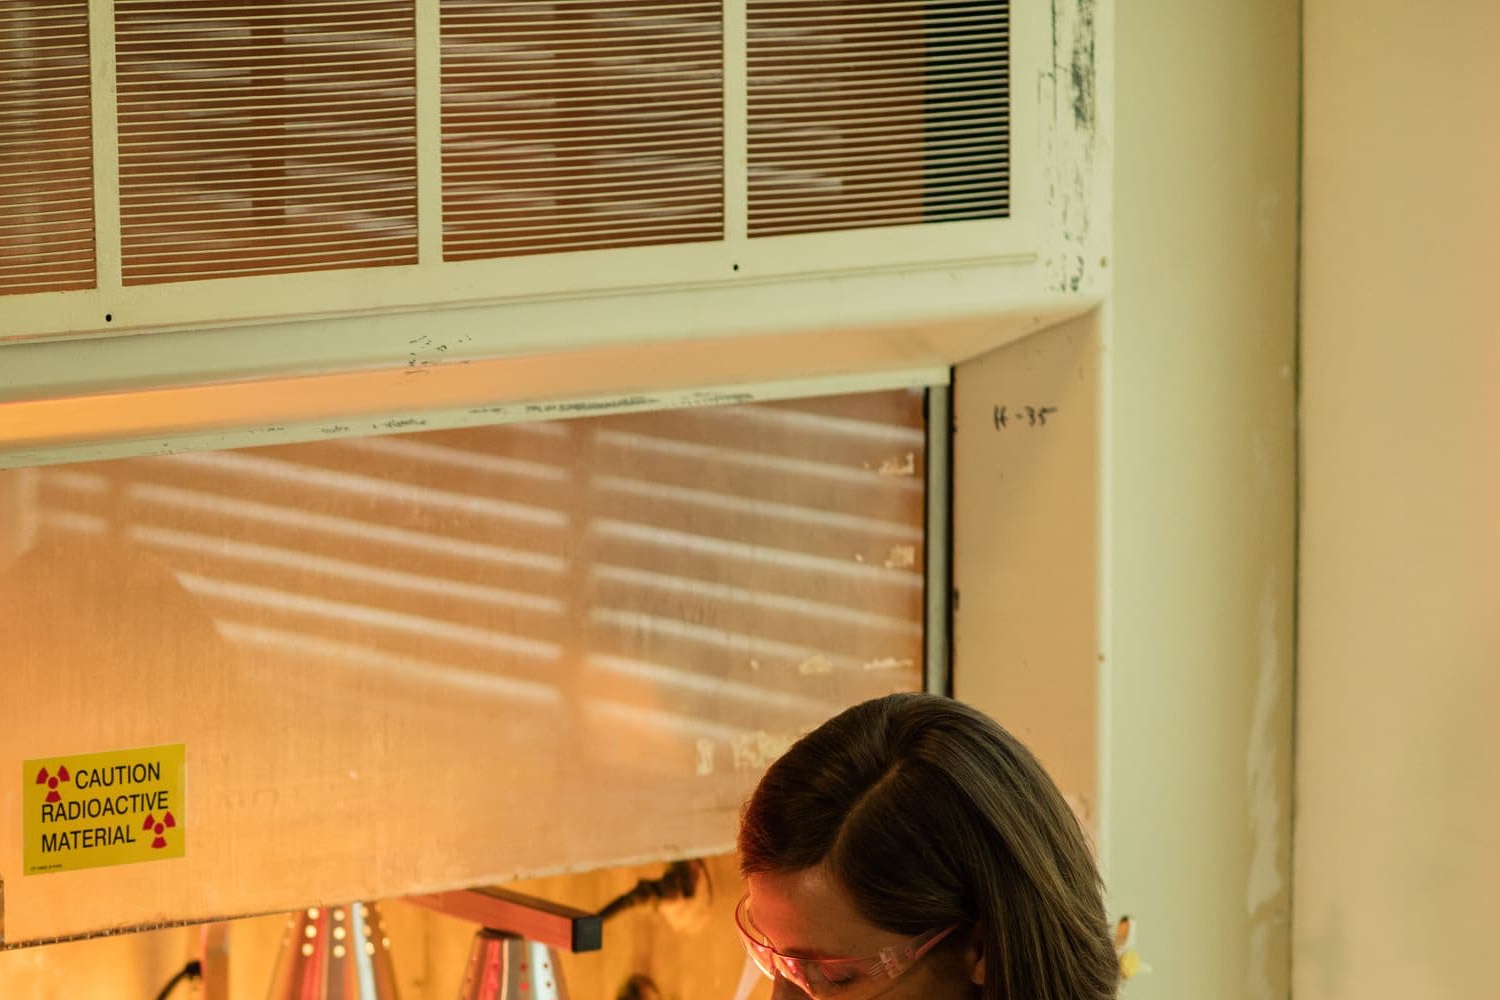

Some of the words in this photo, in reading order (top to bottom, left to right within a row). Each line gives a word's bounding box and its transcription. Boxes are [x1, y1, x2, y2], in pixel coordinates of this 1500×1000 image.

[993, 404, 1059, 432] H-35
[75, 761, 160, 790] CAUTION
[41, 790, 168, 823] RADIOACTIVE
[41, 824, 136, 853] MATERIAL
